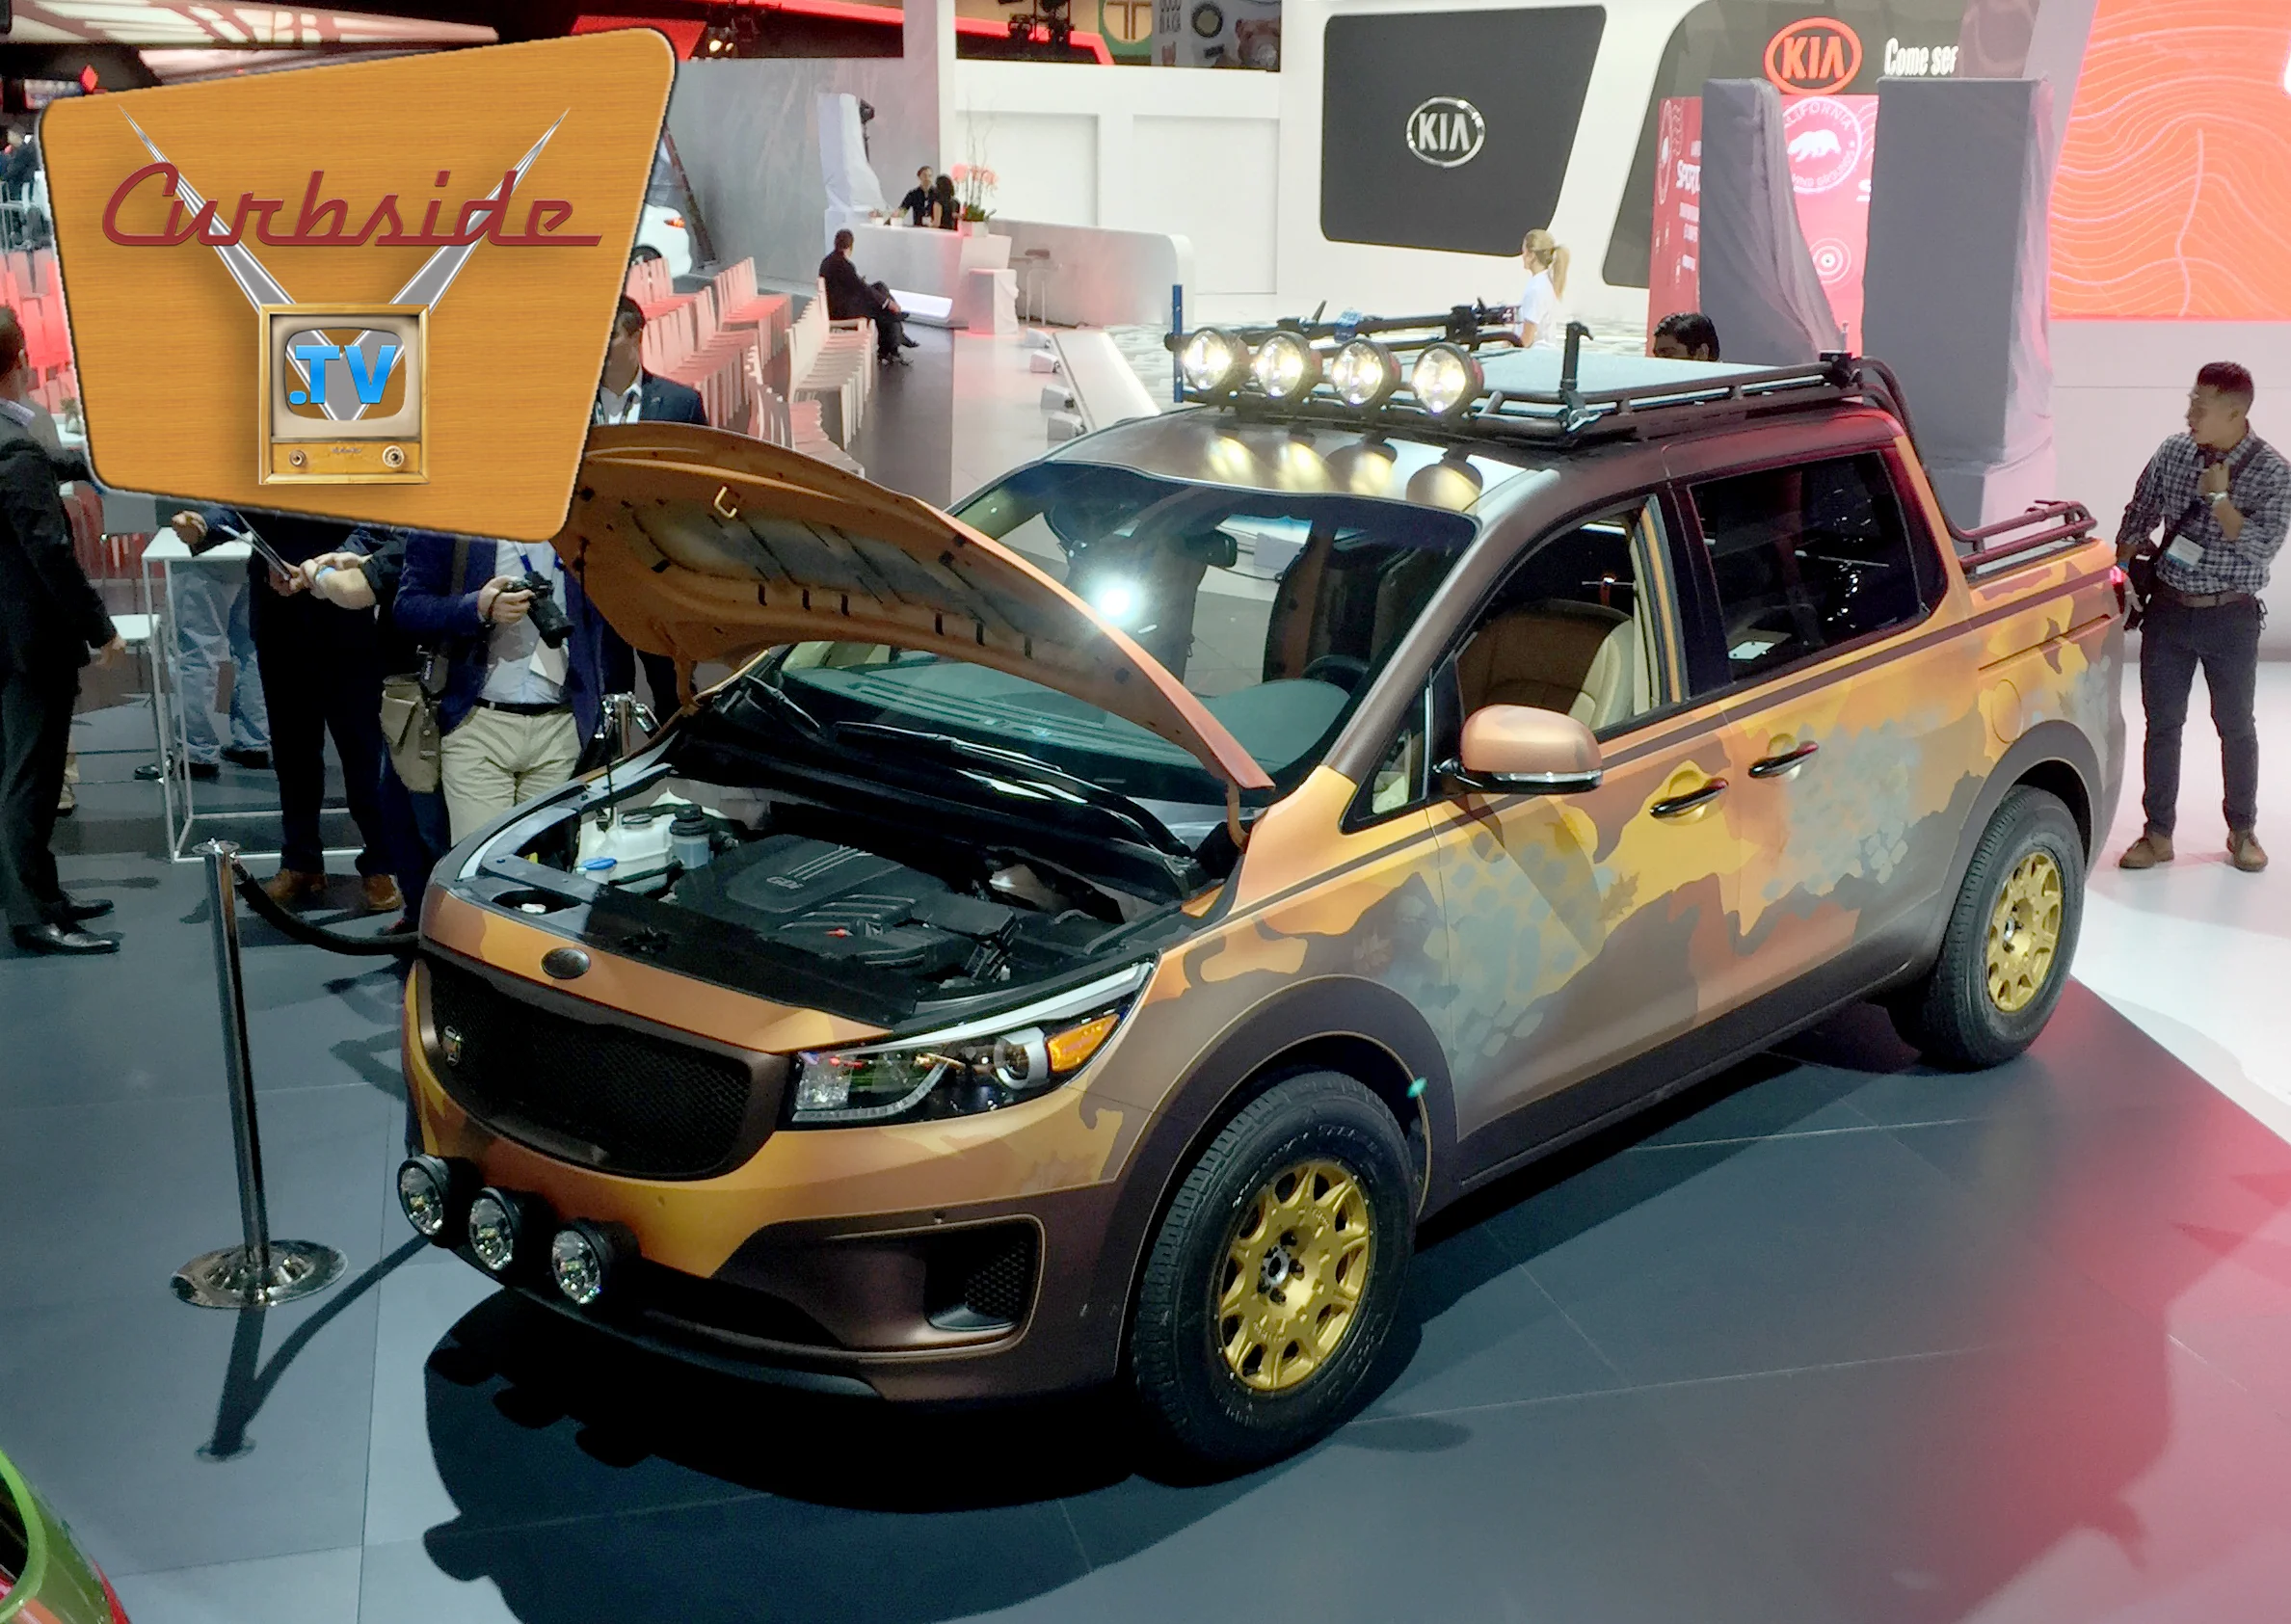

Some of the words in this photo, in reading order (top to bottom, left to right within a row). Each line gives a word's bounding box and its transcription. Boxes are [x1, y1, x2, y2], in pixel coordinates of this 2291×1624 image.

[1782, 36, 1846, 79] KIA
[1883, 38, 1929, 76] Come
[1419, 113, 1471, 151] KIA
